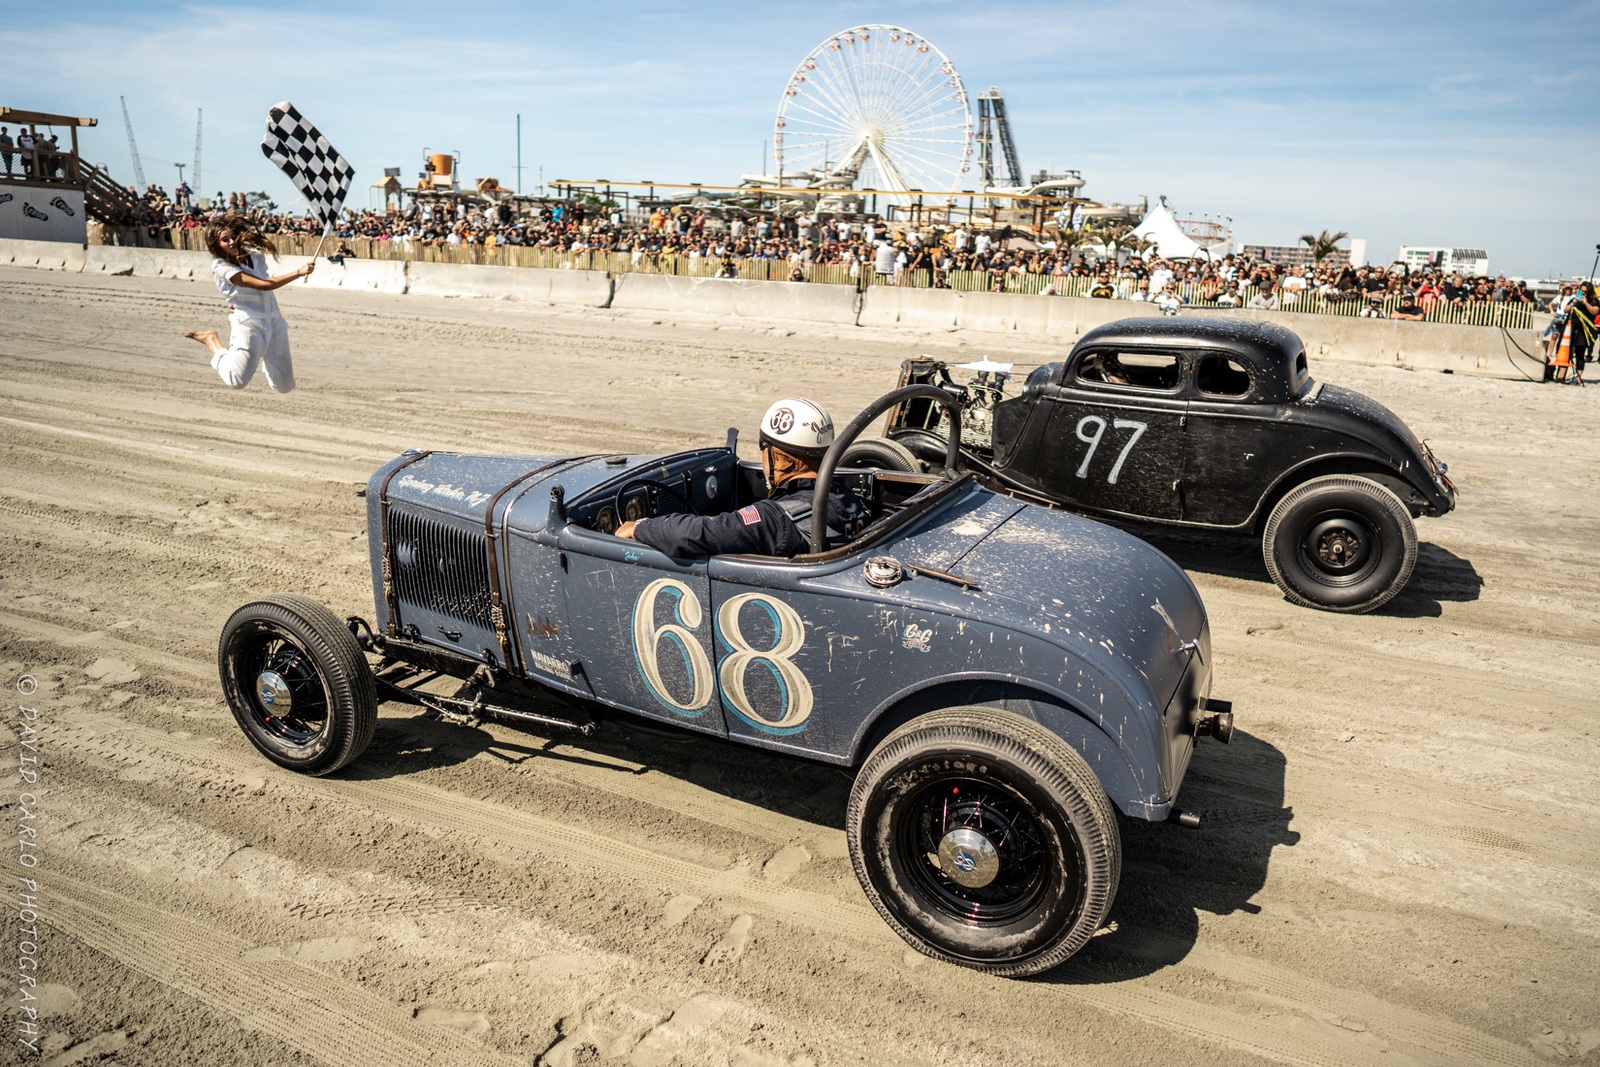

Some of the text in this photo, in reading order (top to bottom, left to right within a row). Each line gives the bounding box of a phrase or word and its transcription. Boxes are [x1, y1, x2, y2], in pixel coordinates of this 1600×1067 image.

[771, 408, 794, 435] 68
[1075, 415, 1147, 484] 97
[398, 475, 434, 494] Spring
[464, 490, 492, 508] NJ
[631, 578, 814, 736] 68
